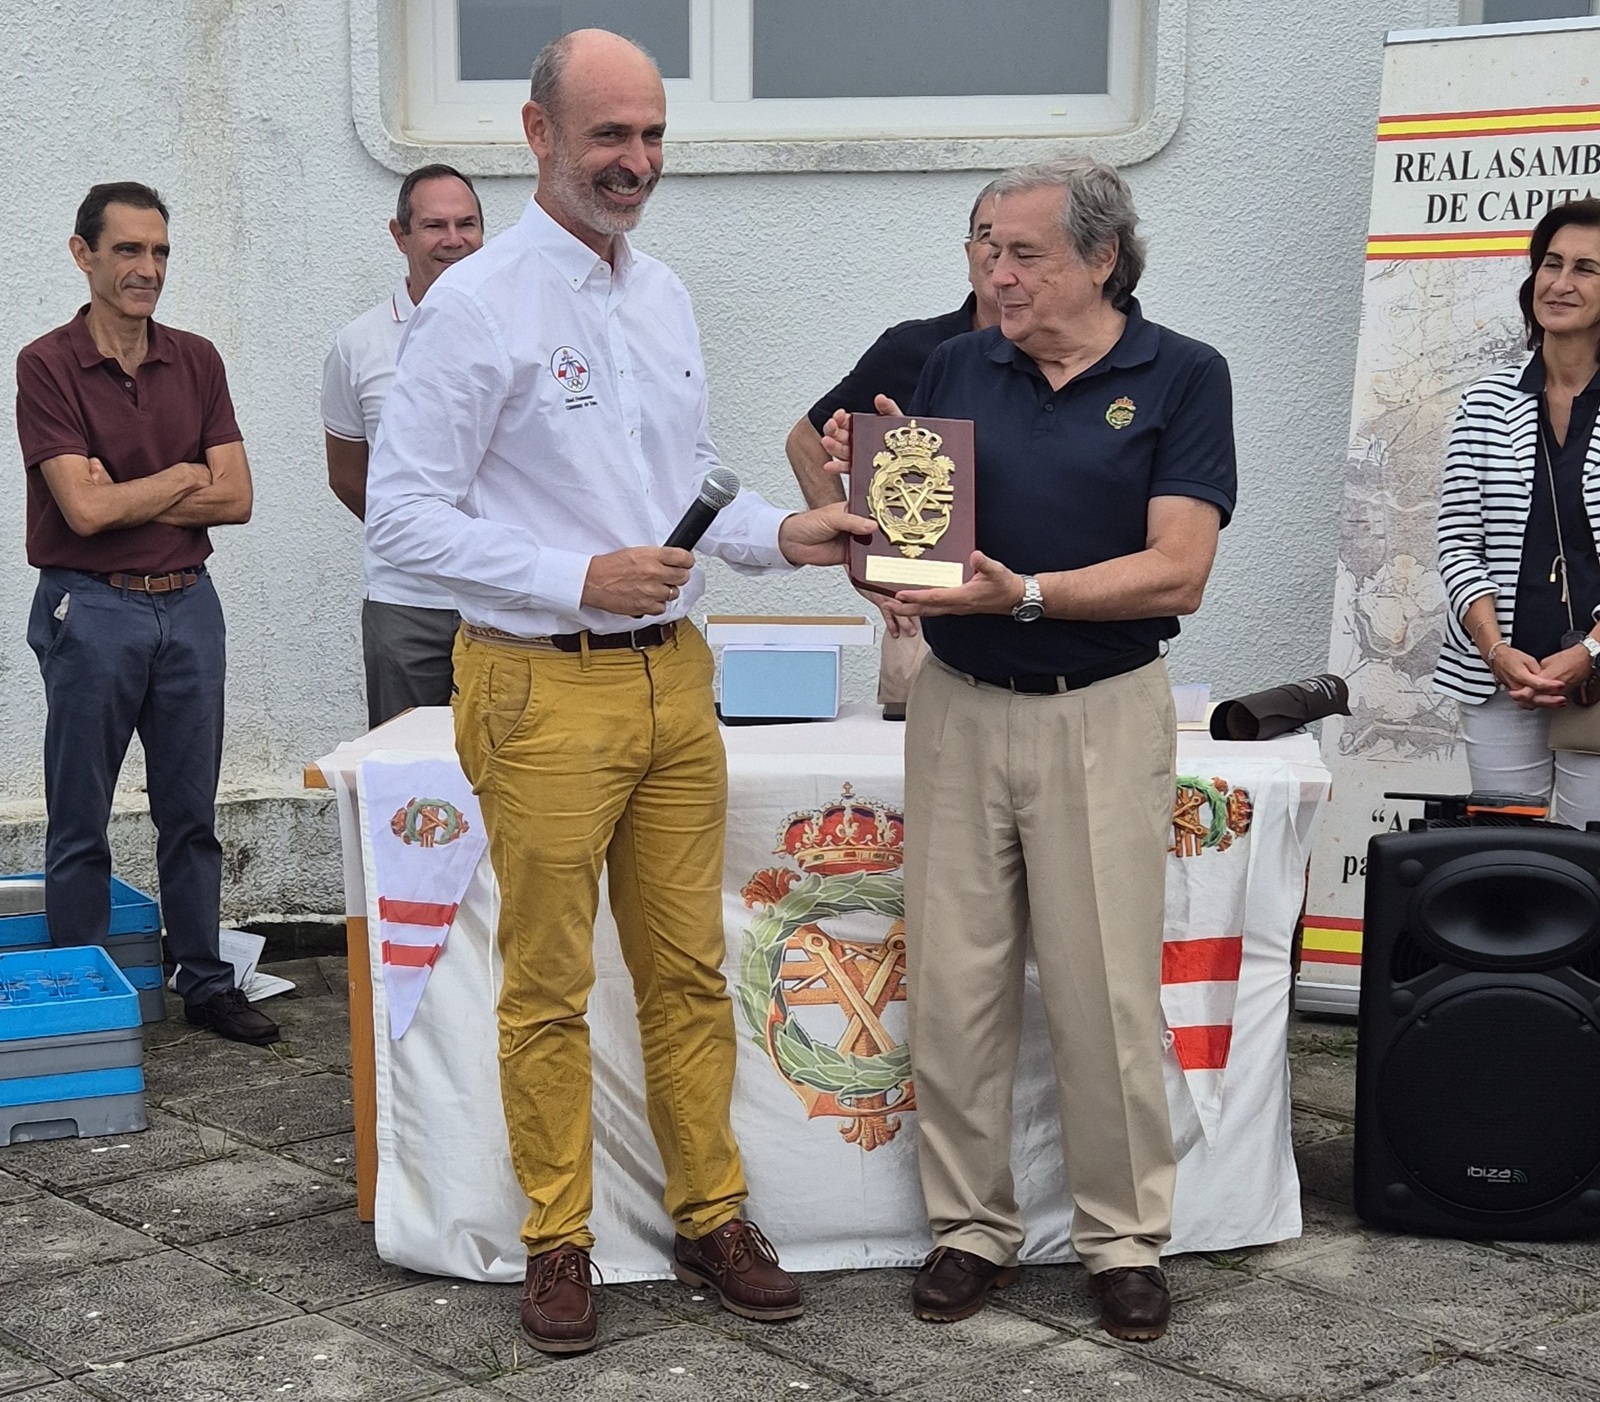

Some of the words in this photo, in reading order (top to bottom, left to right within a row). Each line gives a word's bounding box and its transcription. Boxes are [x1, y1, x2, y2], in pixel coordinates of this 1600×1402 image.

[1393, 150, 1480, 182] REAL
[1485, 144, 1600, 179] ASAMB
[1425, 193, 1468, 223] DE
[1467, 1166, 1512, 1179] ibiza
